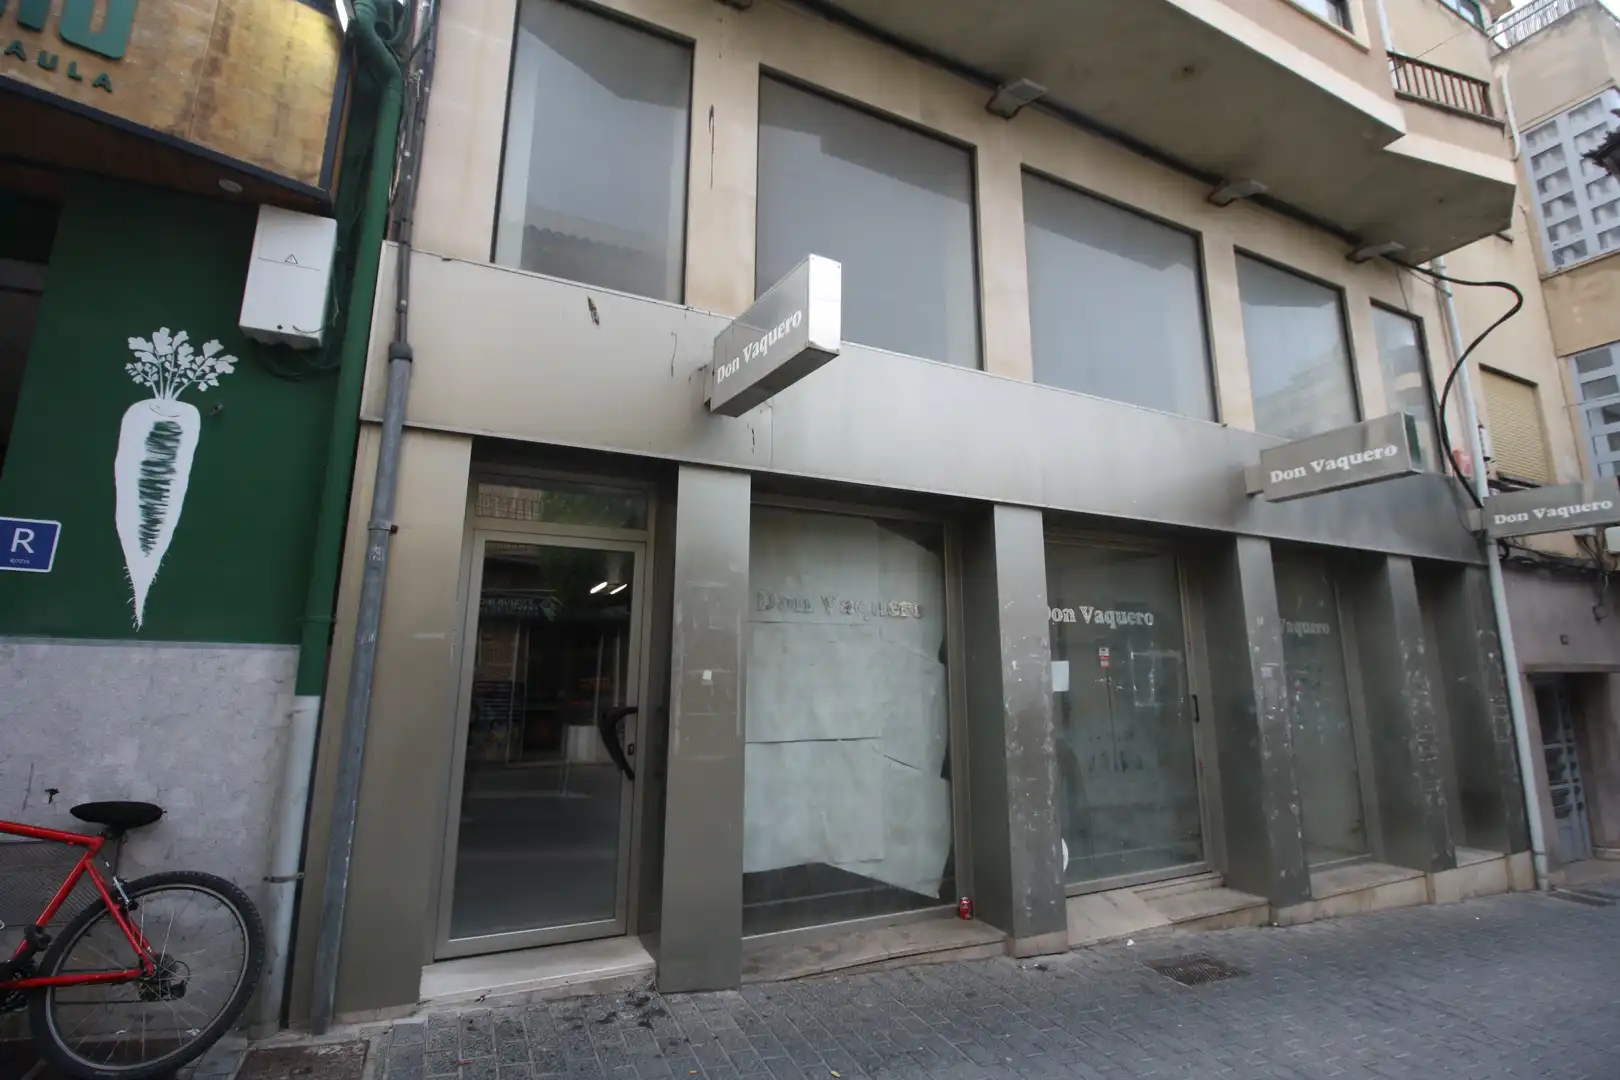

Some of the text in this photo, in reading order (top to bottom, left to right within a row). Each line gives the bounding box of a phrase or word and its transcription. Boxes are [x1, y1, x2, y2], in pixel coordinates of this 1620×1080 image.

[716, 309, 803, 384] Don Vaquero
[1269, 444, 1398, 484] Don Vaquero
[1493, 500, 1614, 525] Don Vaquero
[10, 527, 36, 554] R
[1079, 605, 1155, 630] Vaquero
